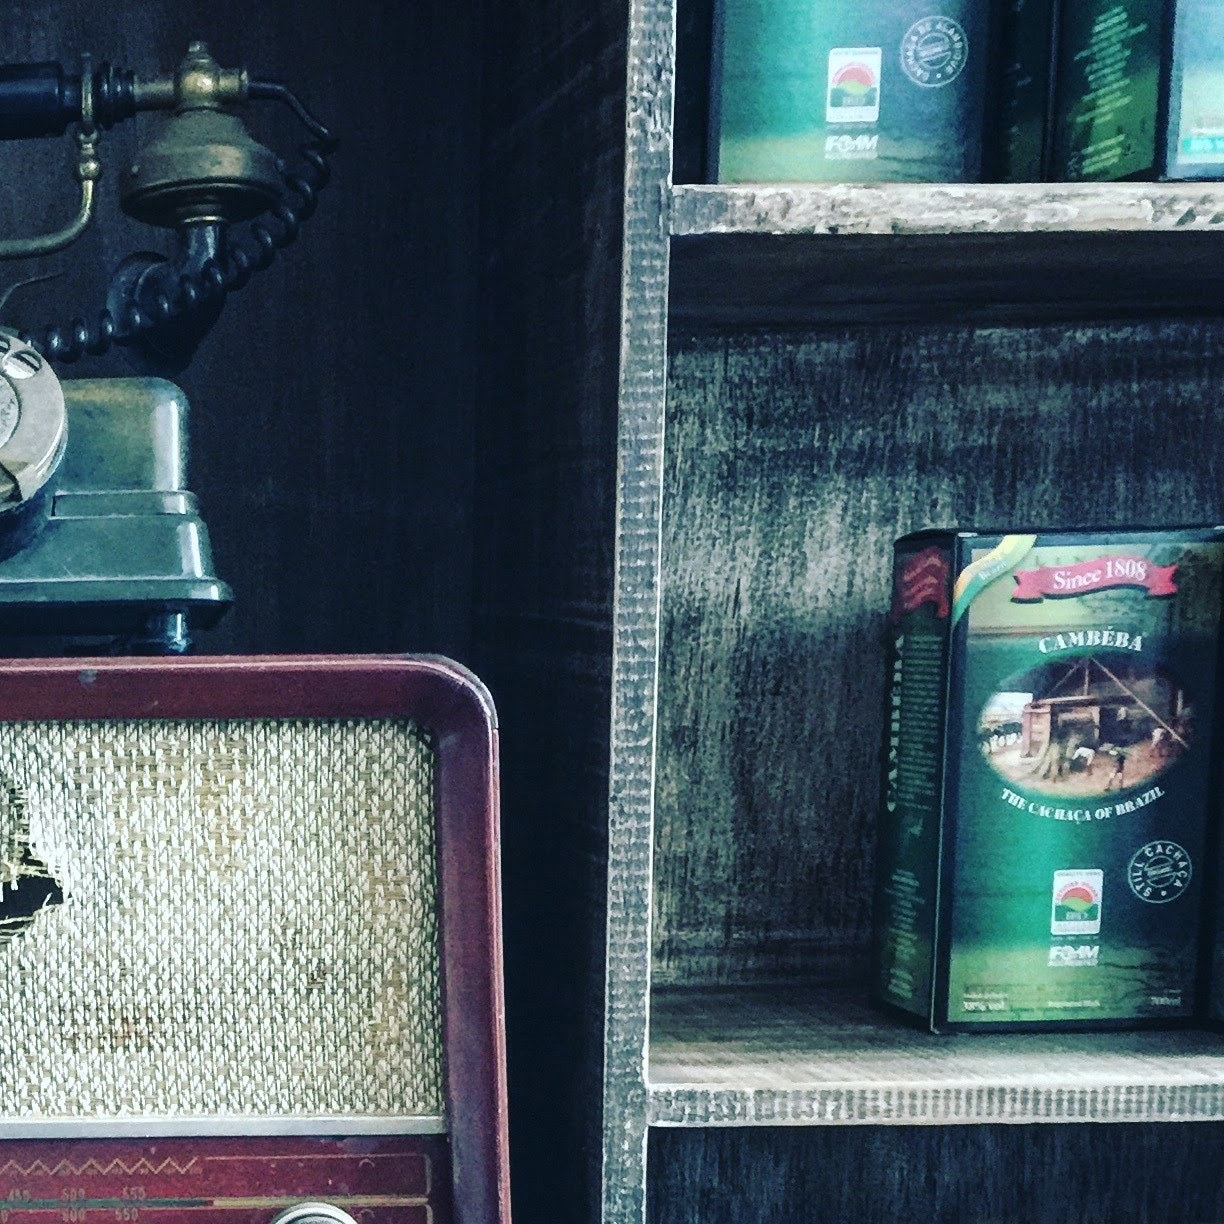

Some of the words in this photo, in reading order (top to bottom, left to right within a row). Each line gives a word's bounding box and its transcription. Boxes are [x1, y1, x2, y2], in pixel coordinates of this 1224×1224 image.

[1053, 569, 1101, 589] Since
[1105, 558, 1147, 581] 1808
[1038, 625, 1142, 654] CAMBÉBA
[1001, 787, 1026, 811] THE
[1028, 802, 1092, 825] CACHAÇA
[1094, 806, 1113, 820] OF
[1114, 786, 1166, 816] BRAZIL
